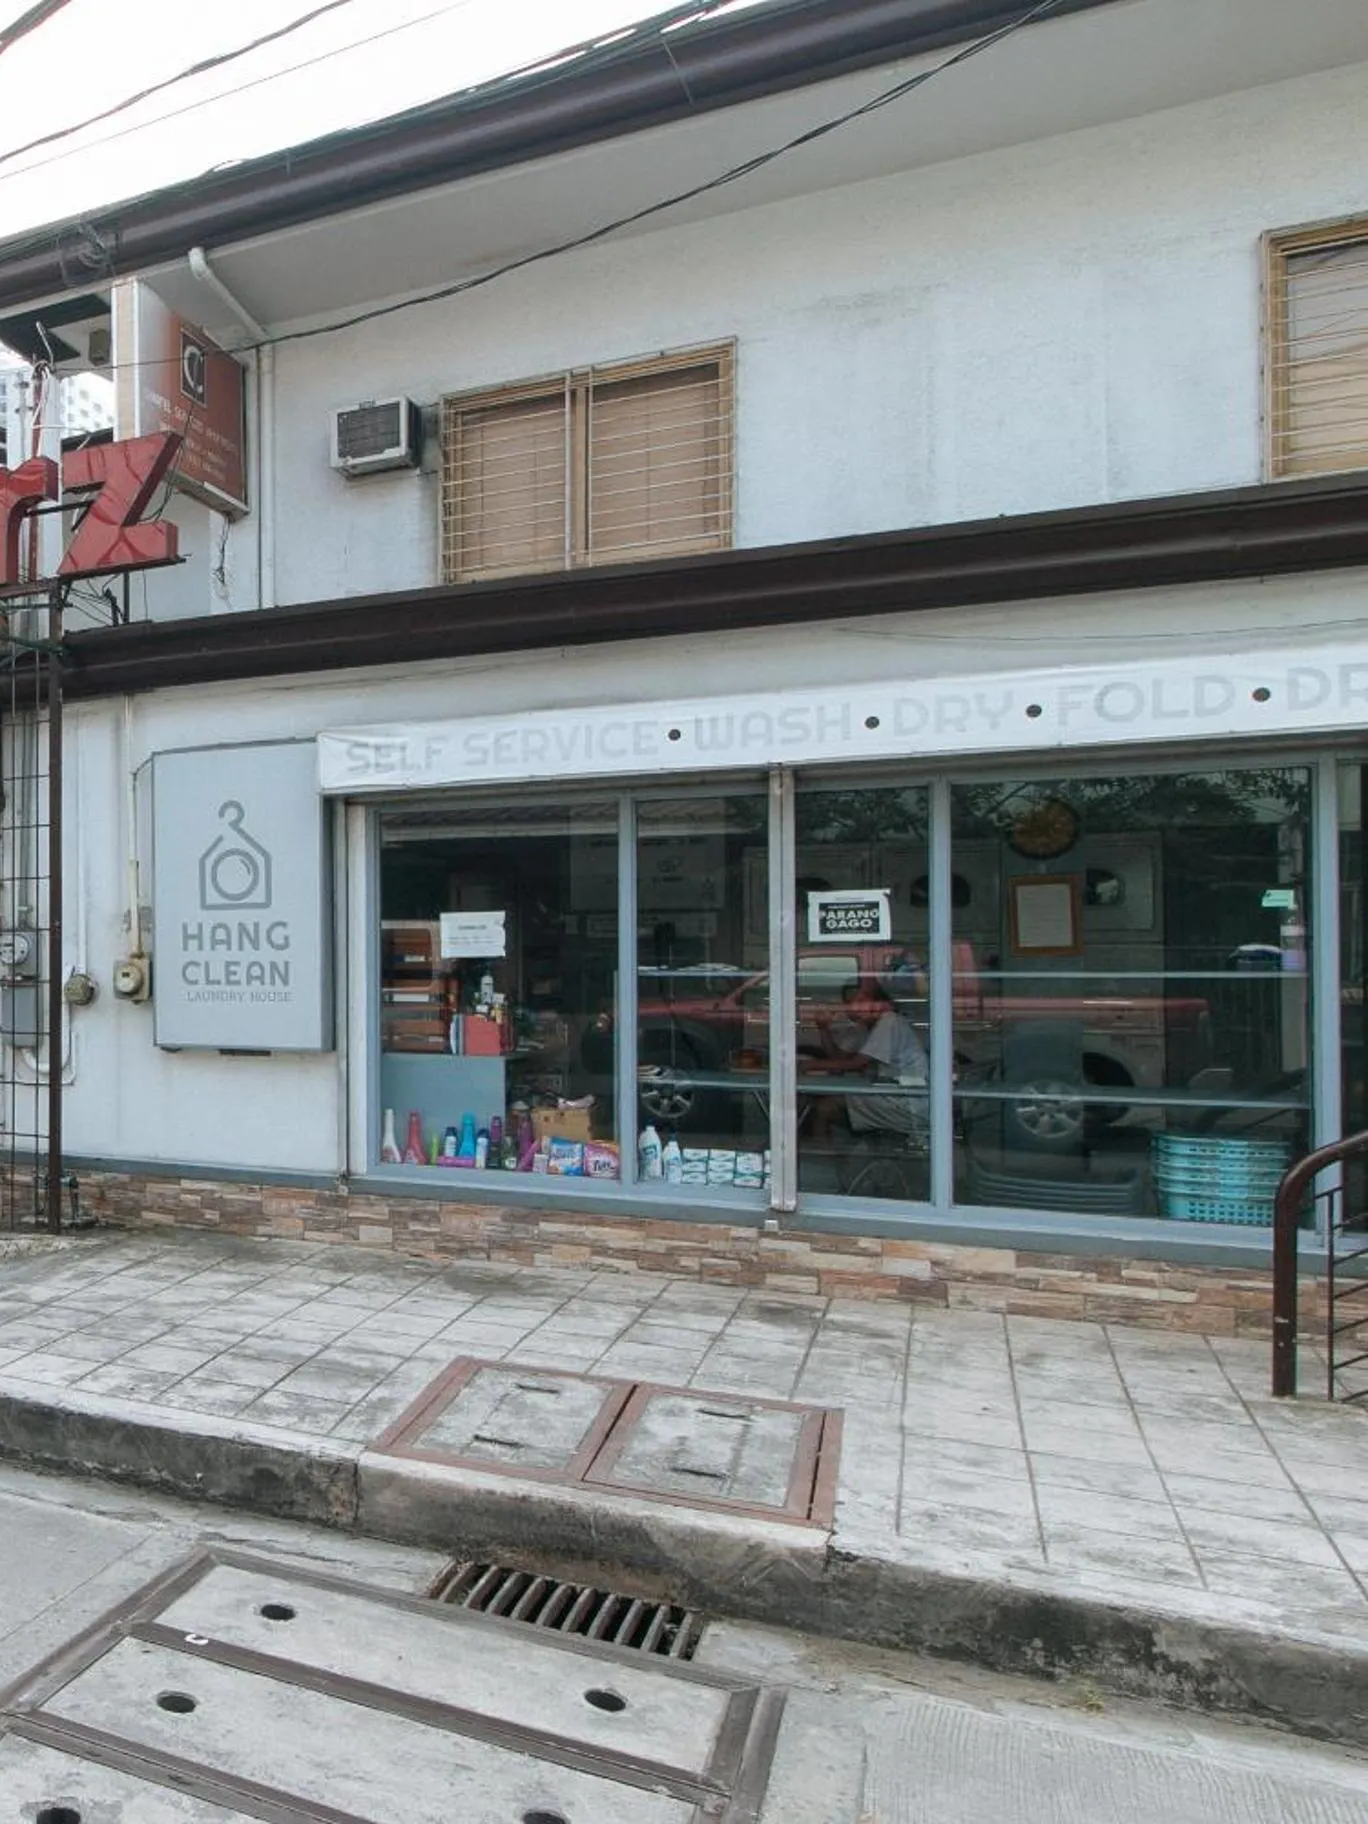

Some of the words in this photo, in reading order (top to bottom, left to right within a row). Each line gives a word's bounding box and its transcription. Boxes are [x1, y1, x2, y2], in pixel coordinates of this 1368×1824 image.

[346, 740, 442, 774] SELF
[463, 720, 659, 768] SERVICE
[694, 703, 852, 751] WASH
[893, 689, 1014, 736] DRY
[1058, 675, 1236, 727] FOLD
[181, 921, 291, 951] HANG
[181, 961, 291, 987] CLEAN
[186, 990, 245, 1002] LAUNDRY
[250, 990, 293, 1002] HOUSE
